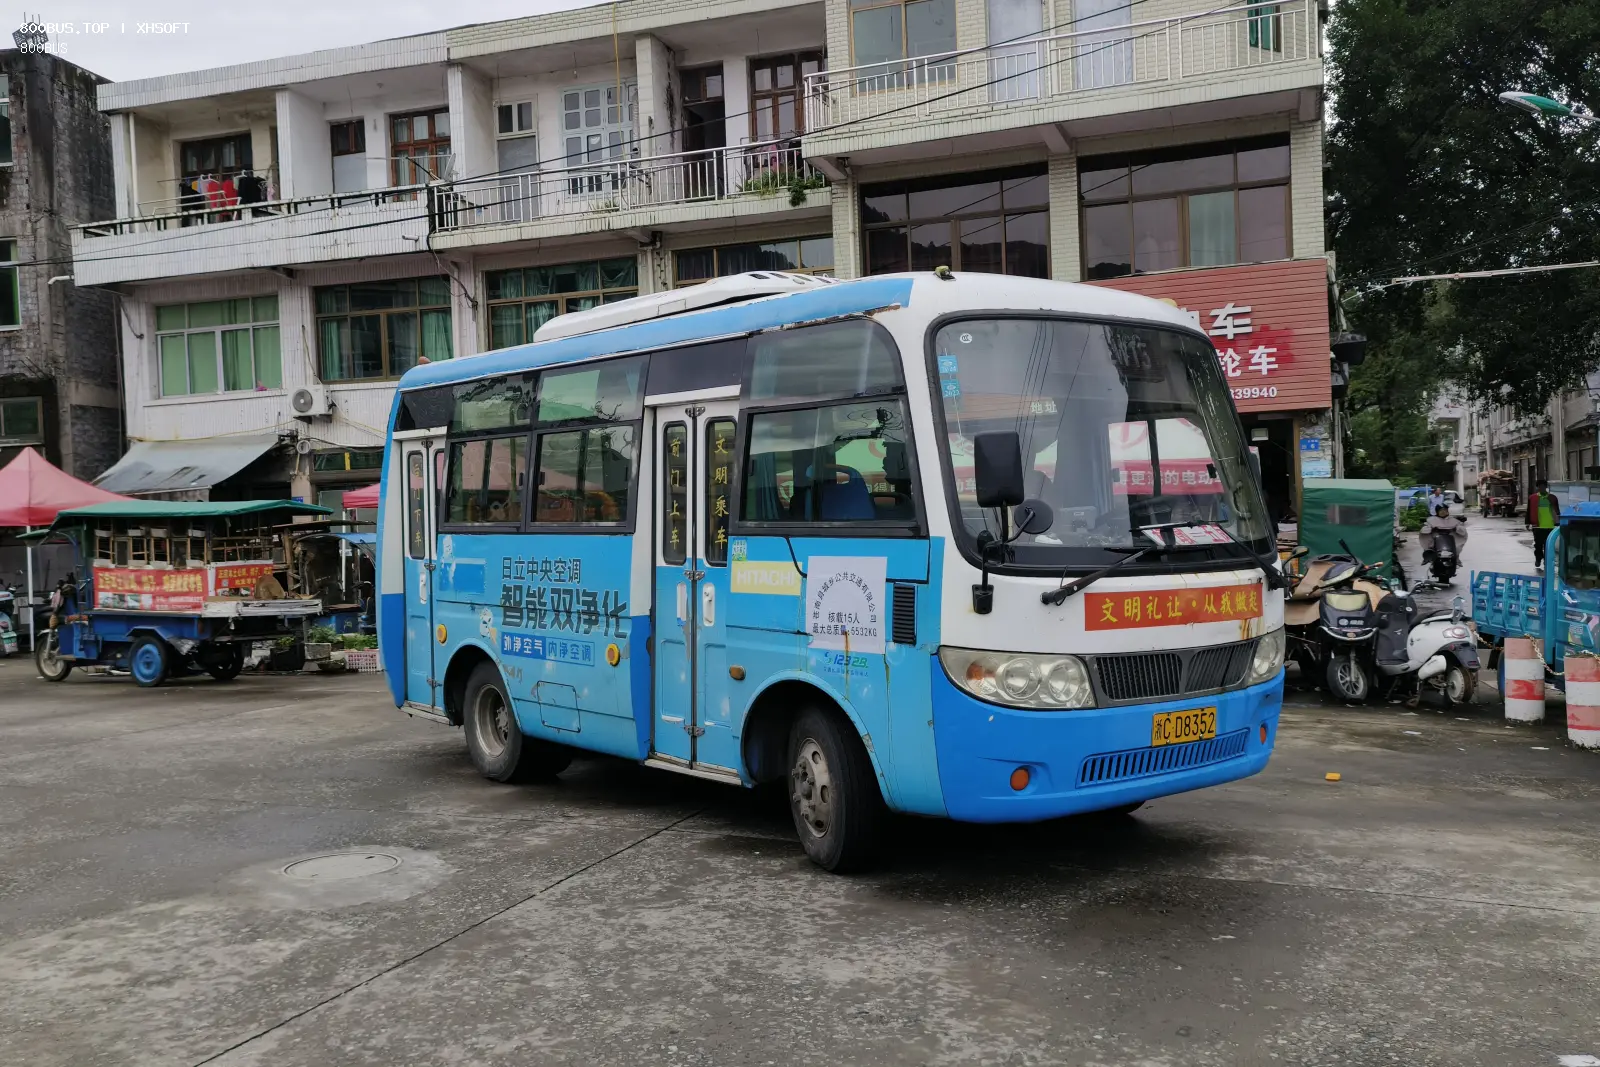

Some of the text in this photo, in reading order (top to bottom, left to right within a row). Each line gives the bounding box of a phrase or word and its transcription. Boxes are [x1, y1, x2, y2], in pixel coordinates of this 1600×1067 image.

[1030, 400, 1058, 414] 地址
[669, 437, 682, 551] 前门上车
[714, 433, 729, 551] 文明乘车
[502, 556, 581, 584] 日立中央空调
[736, 569, 796, 586] HITACHI
[501, 583, 628, 639] 智能双净化
[828, 611, 860, 624] 核载15人
[503, 634, 543, 655] 外净空气
[547, 641, 592, 662] 内净空调
